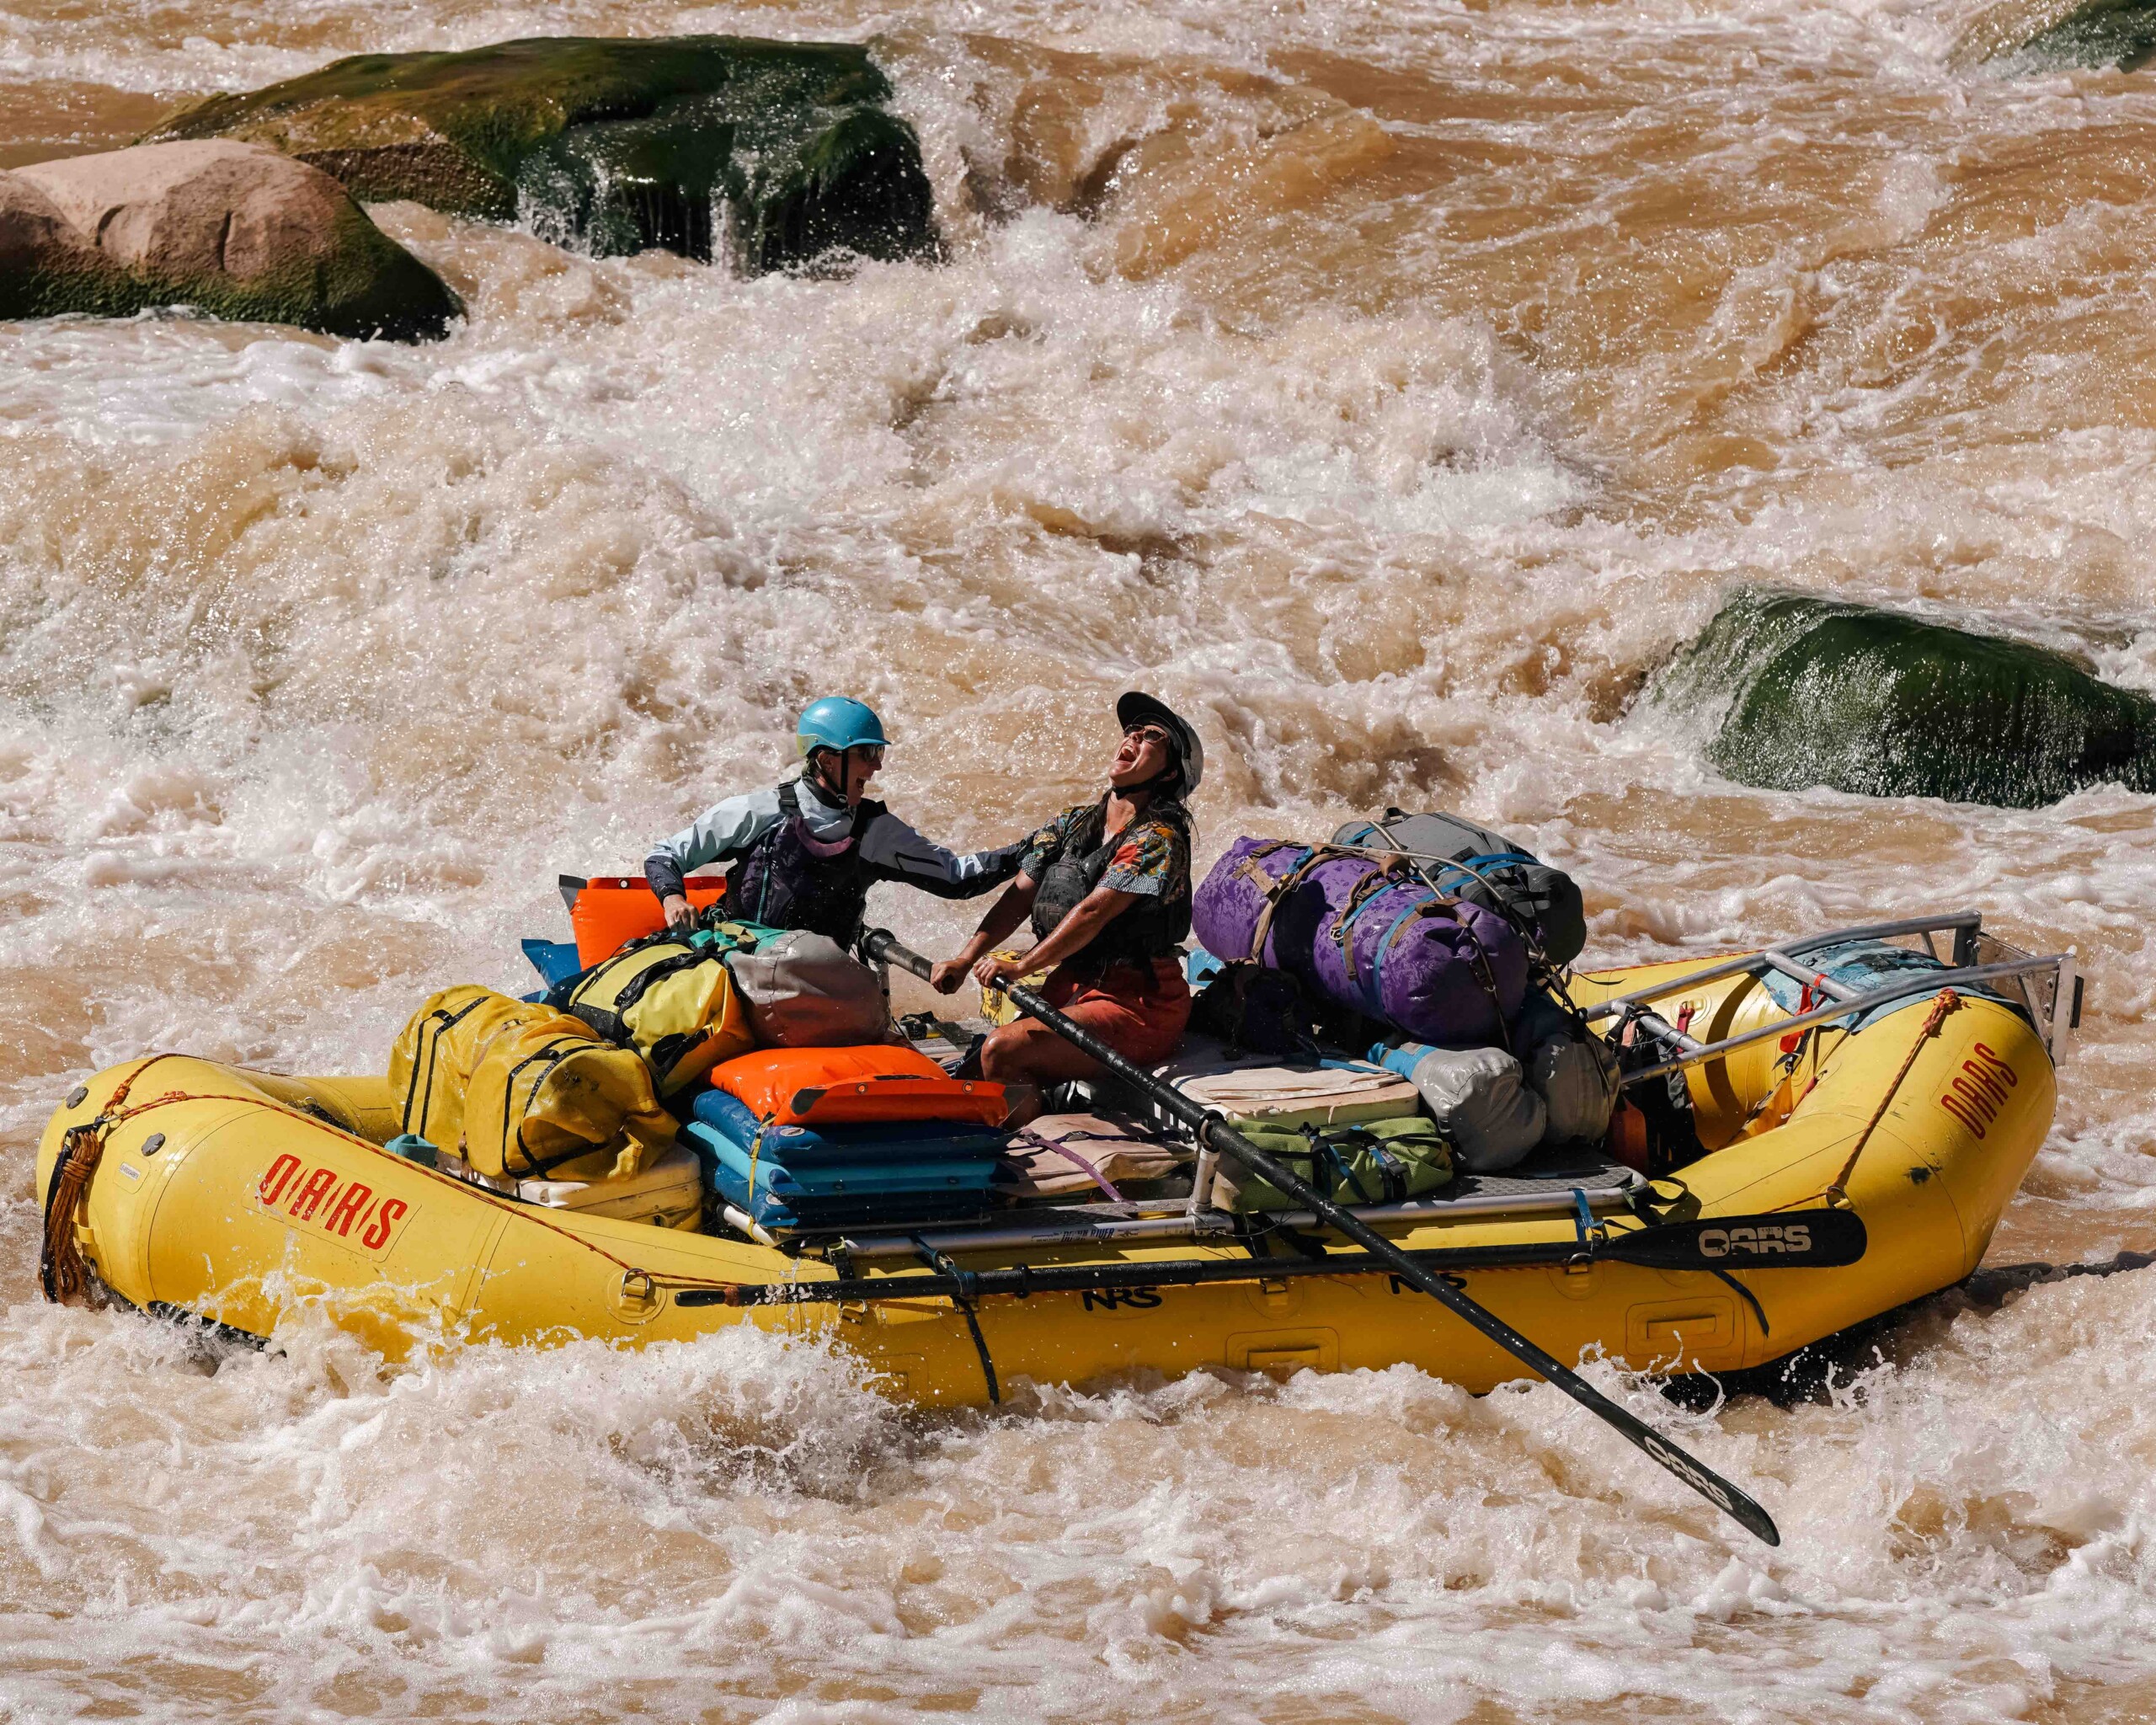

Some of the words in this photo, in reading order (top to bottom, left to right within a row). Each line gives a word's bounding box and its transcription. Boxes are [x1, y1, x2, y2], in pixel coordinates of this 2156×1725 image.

[1090, 1228, 1115, 1240] RIVER
[1698, 1225, 1812, 1258] OARS
[1389, 1272, 1468, 1295] NS
[1081, 1286, 1162, 1311] NRS
[1644, 1435, 1733, 1510] OARS
